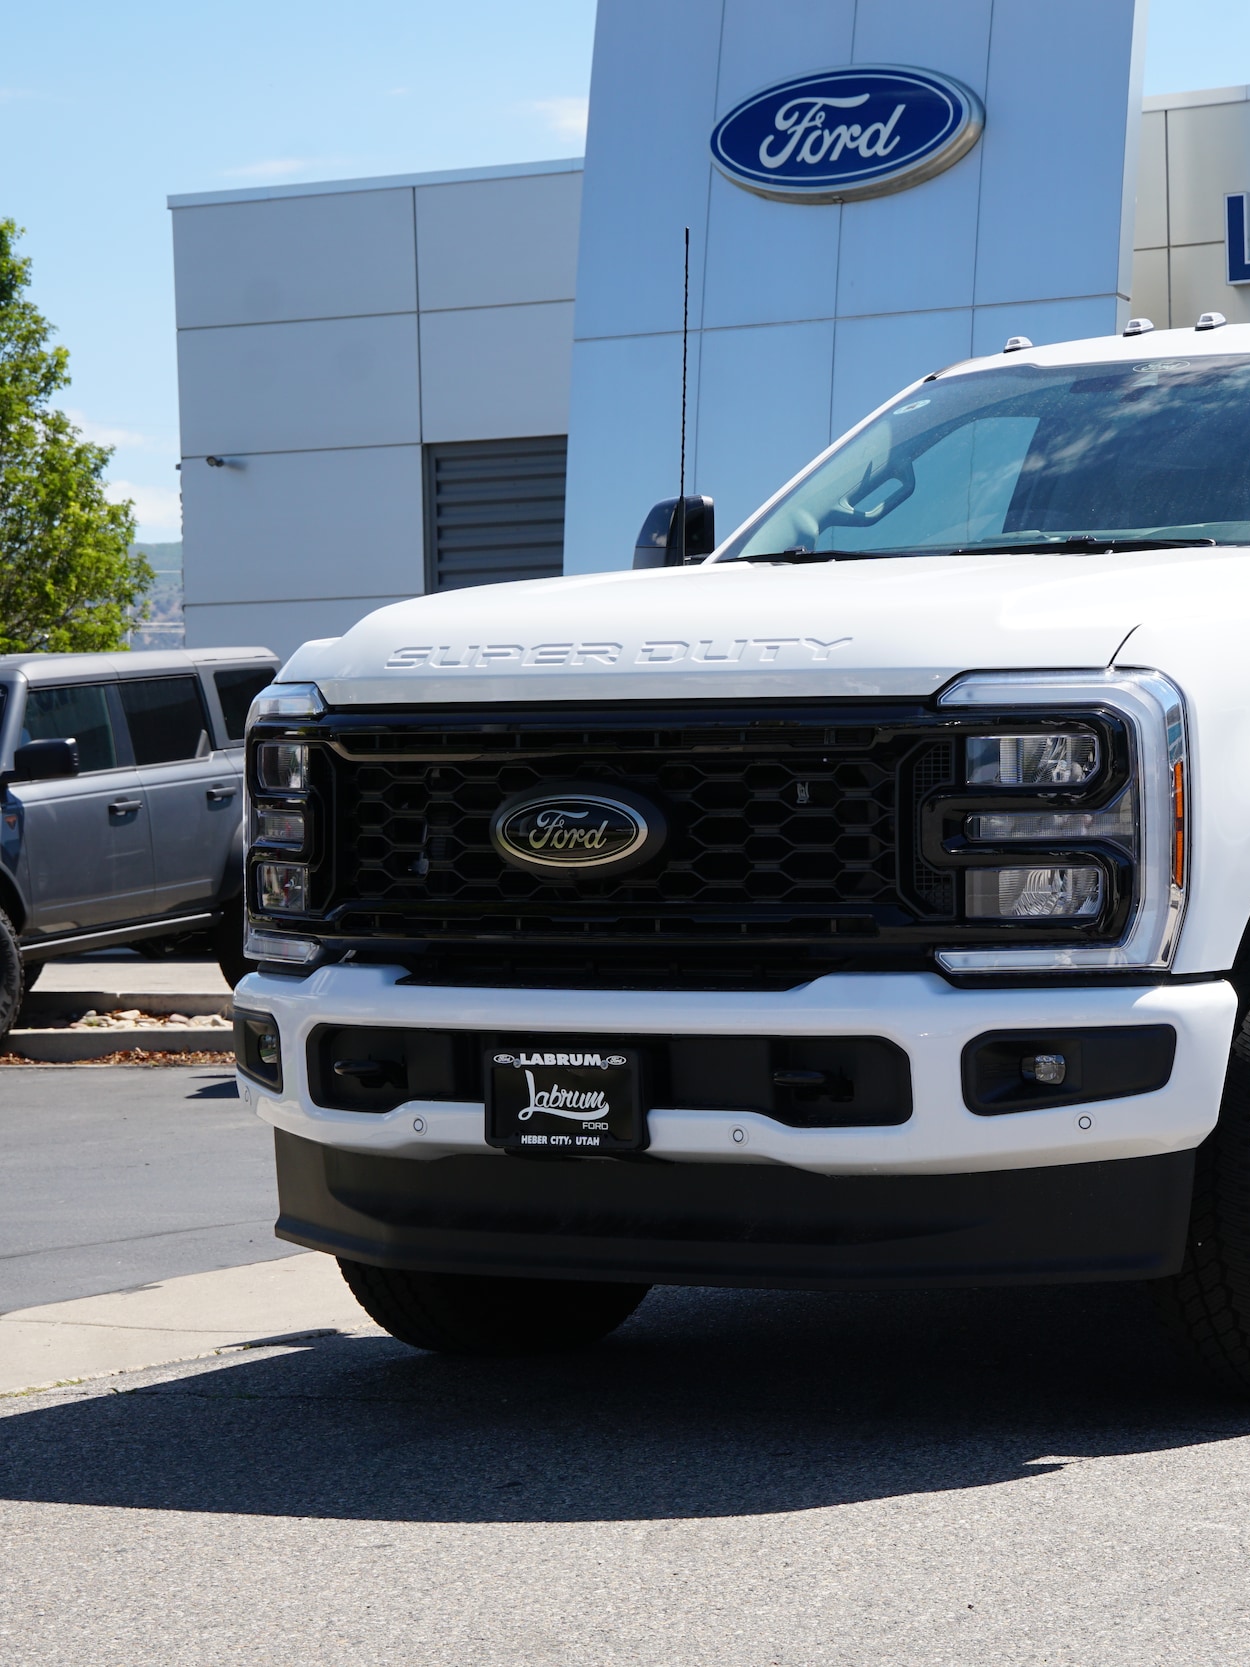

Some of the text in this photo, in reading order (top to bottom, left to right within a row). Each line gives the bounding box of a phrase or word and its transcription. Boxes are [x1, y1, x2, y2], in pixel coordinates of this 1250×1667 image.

[759, 93, 905, 168] Ford
[384, 637, 853, 669] SUPER DUTY
[529, 810, 608, 849] Ford
[519, 1053, 601, 1066] LABRUM
[518, 1069, 610, 1121] Labrum
[521, 1135, 548, 1145] HEBER
[575, 1136, 600, 1146] UTAH
[582, 1122, 609, 1131] FORD
